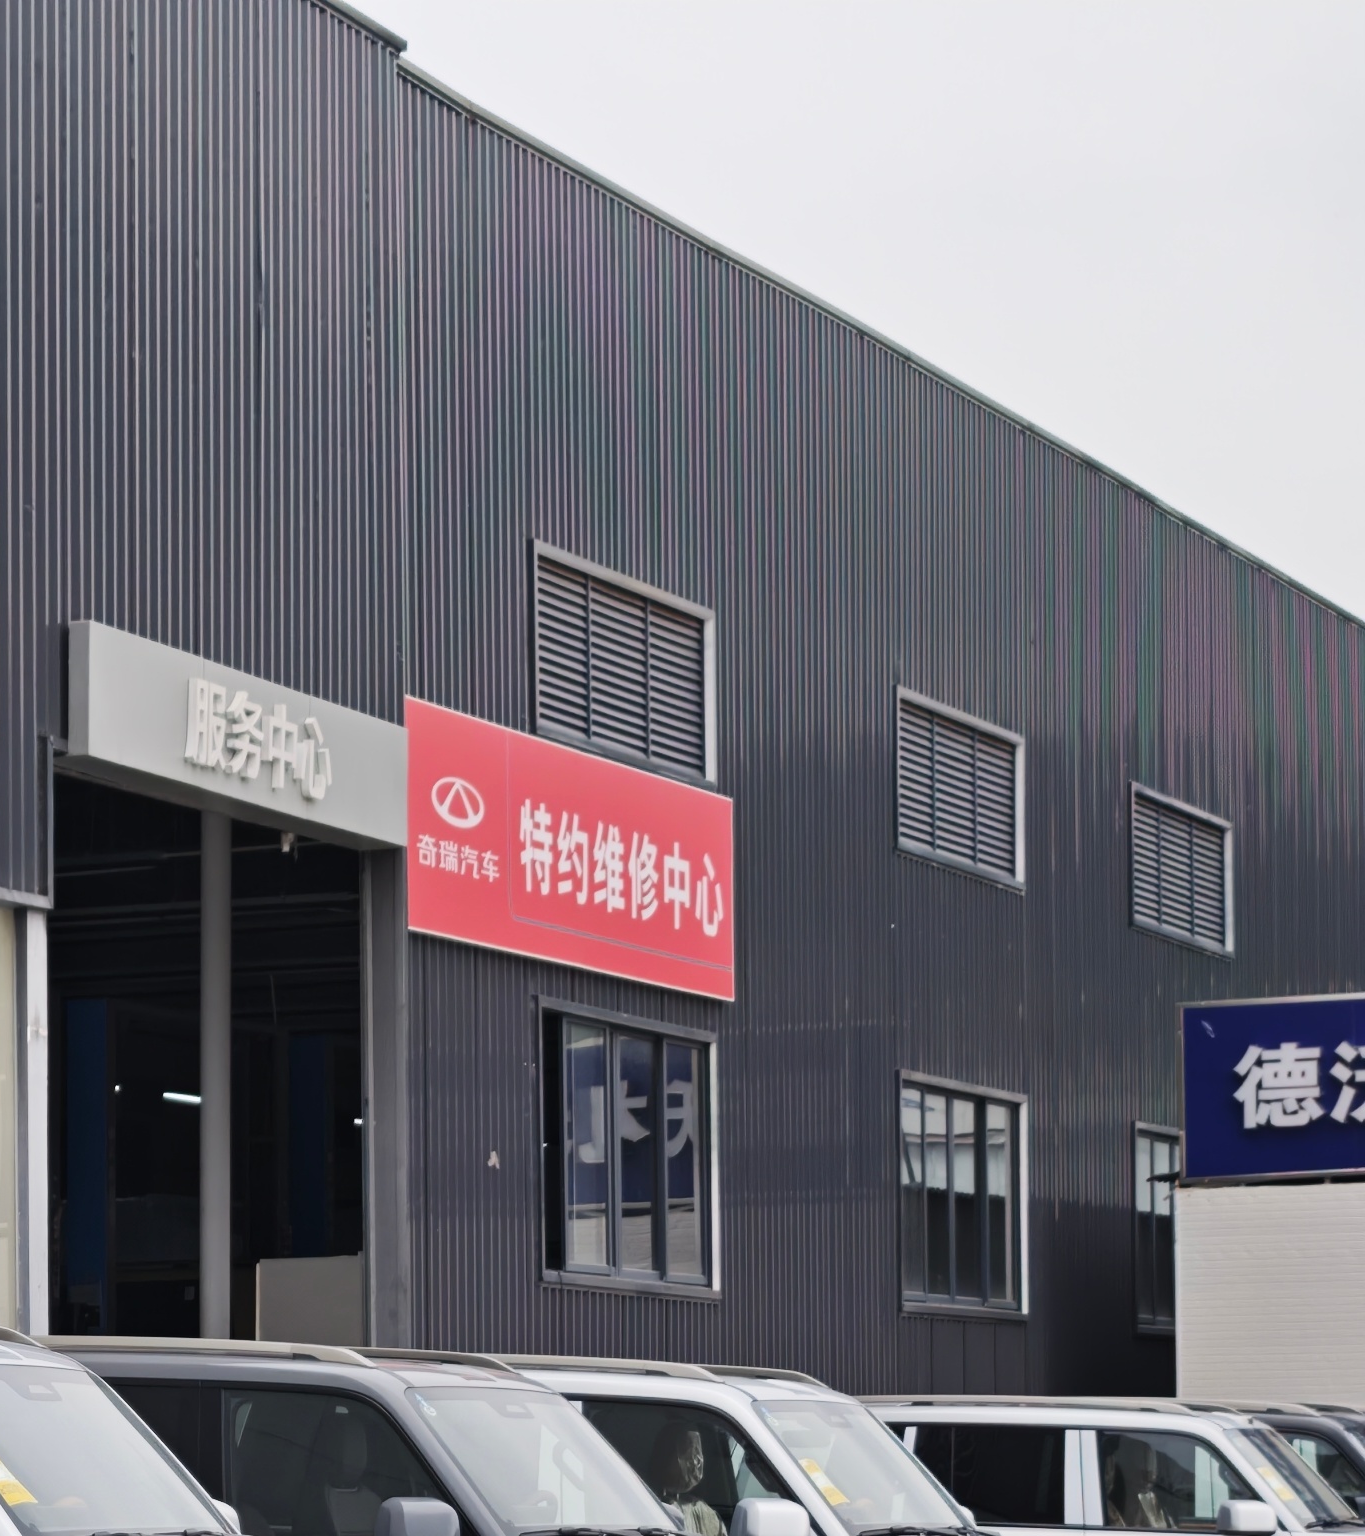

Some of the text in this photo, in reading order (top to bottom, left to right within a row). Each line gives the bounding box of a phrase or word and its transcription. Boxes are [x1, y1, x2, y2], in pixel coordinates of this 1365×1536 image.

[184, 677, 333, 801] 服务中心
[416, 833, 501, 884] 奇瑞汽车
[519, 798, 725, 938] 特约维修中心
